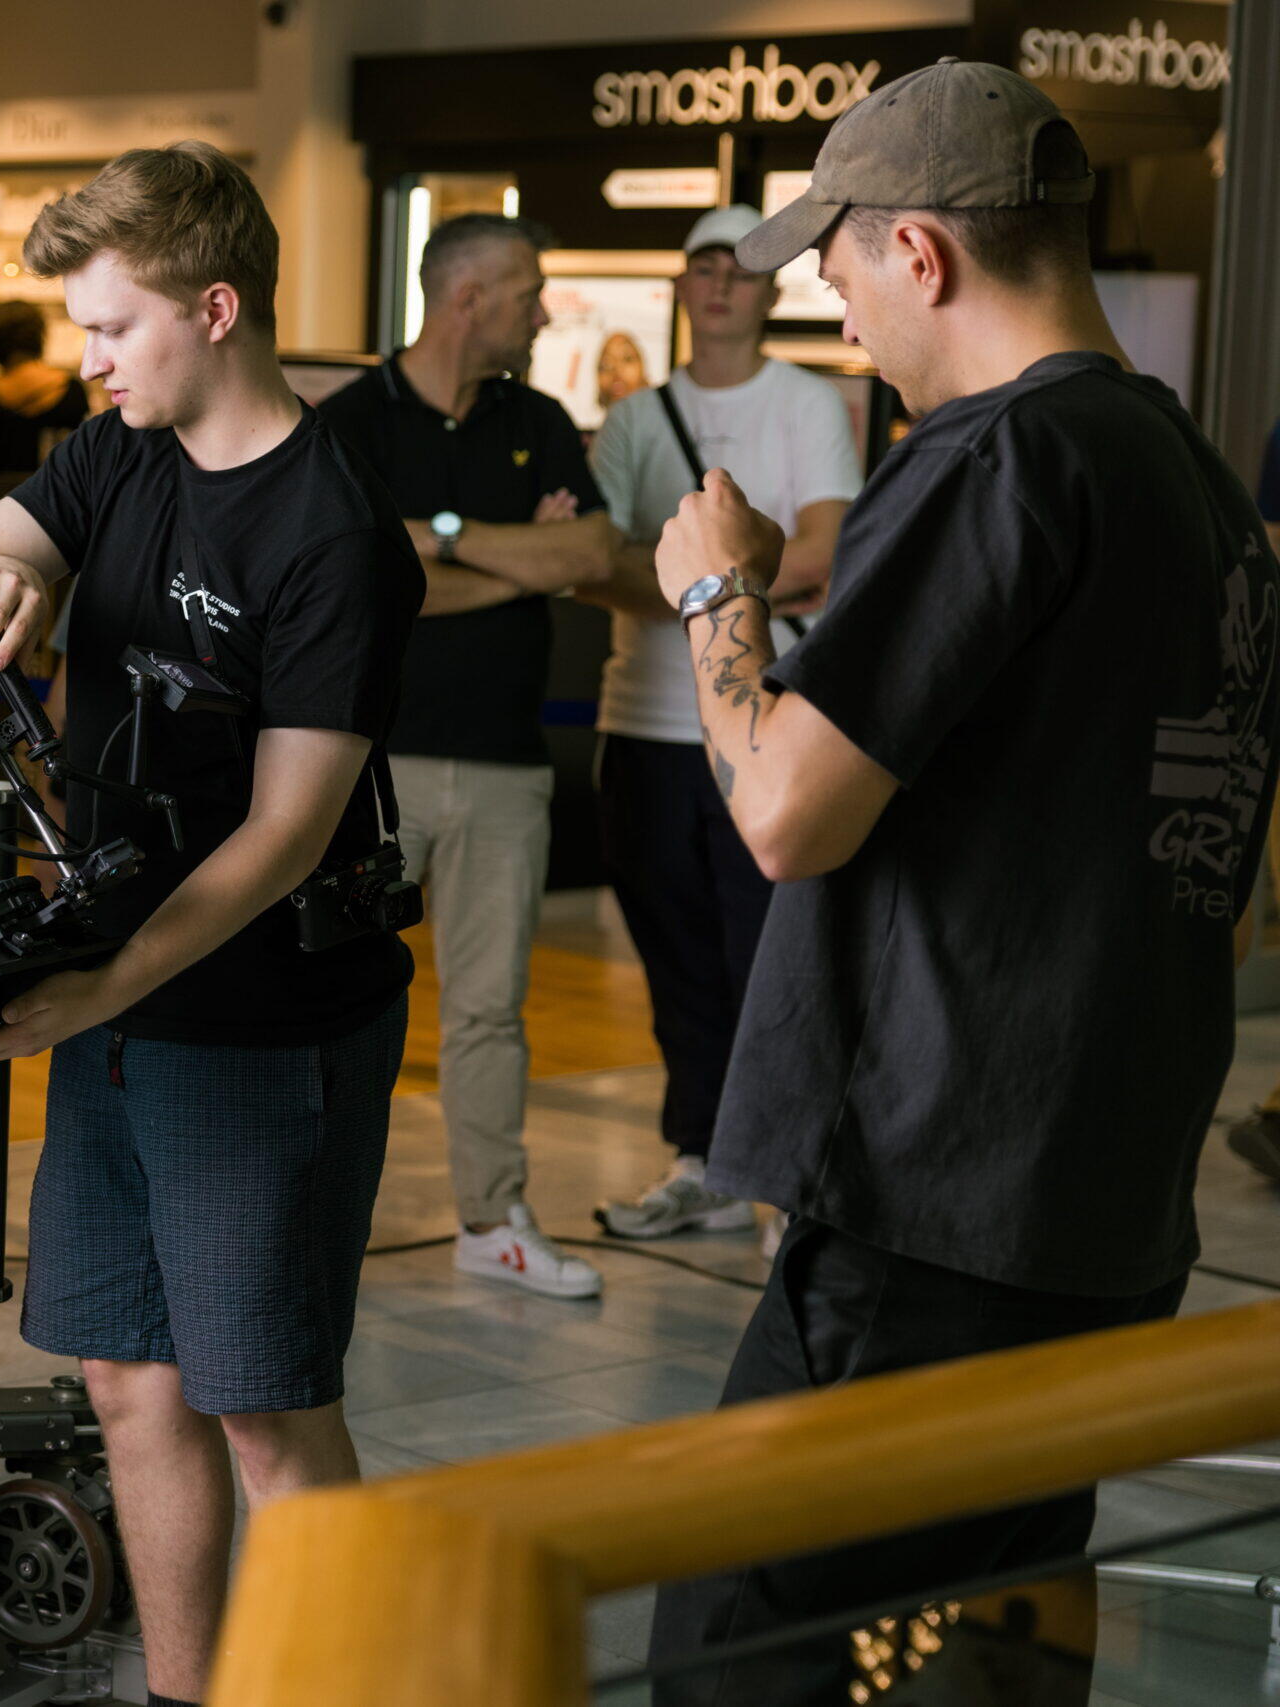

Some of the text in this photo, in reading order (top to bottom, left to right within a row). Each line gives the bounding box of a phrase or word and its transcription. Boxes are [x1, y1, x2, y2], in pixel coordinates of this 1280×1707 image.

[592, 43, 882, 128] smashbox
[1019, 16, 1233, 91] smashbox
[208, 594, 241, 617] STUDIOS
